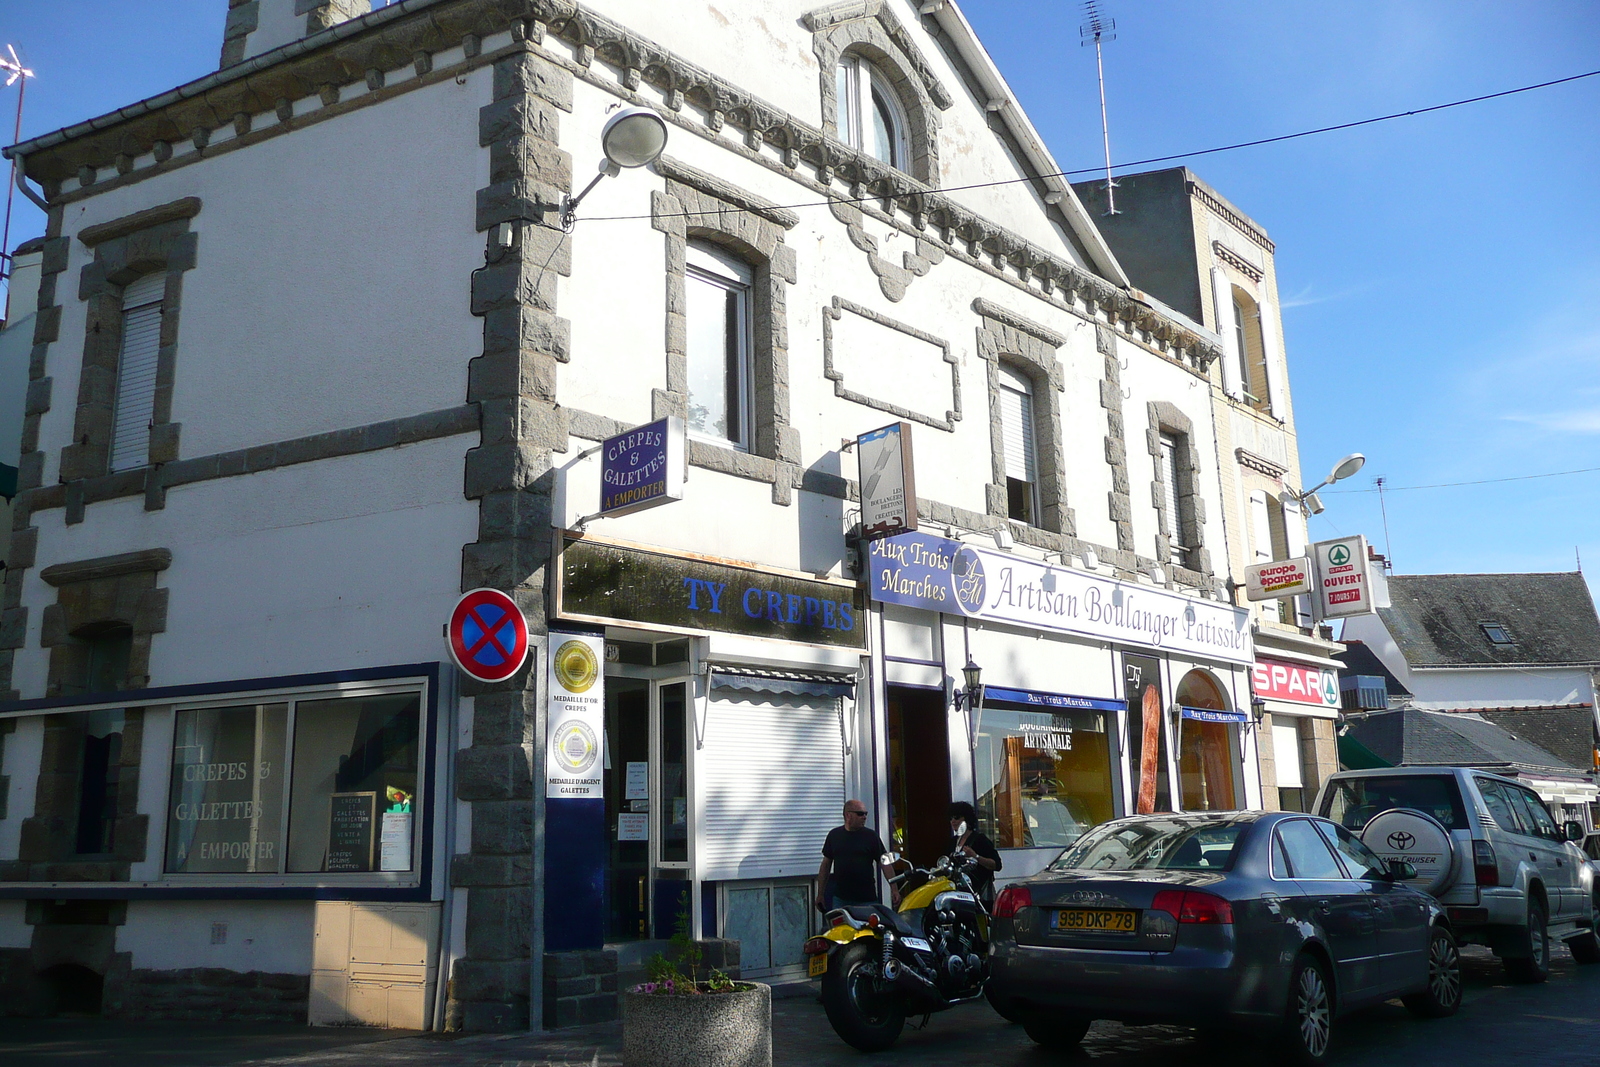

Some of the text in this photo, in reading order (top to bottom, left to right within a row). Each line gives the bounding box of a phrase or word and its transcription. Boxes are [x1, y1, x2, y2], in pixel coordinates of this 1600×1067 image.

[608, 431, 662, 461] CREPES
[630, 452, 640, 466] &
[604, 451, 666, 486] GALETTES
[605, 480, 664, 509] A EMPORTER
[870, 494, 902, 506] BOULANGERS
[880, 500, 903, 510] BRETONS
[872, 538, 948, 570] Aux Trois
[1260, 564, 1296, 576] europe
[1330, 564, 1352, 574] SPAR
[882, 568, 946, 602] Marches
[1260, 572, 1304, 586] epargne
[1324, 574, 1362, 588] OUVERT
[684, 577, 854, 632] TY CREPES
[990, 567, 1248, 650] Artisan Boulanger Patissier
[1126, 664, 1142, 689] Ty
[1253, 664, 1322, 698] SPAR
[554, 695, 583, 703] MEDAILLE
[1028, 694, 1092, 707] Aux Trois Marches
[565, 704, 587, 712] CREPES
[1202, 712, 1216, 720] Trois
[1018, 714, 1072, 733] BOULANGERIE
[1024, 733, 1072, 750] ARTISANALE
[184, 761, 271, 781] CREPES &
[175, 800, 262, 820] GALETTES
[178, 842, 274, 859] A EMPORTER
[1401, 856, 1436, 864] CRUISER
[1059, 912, 1133, 928] 995 DKP 78
